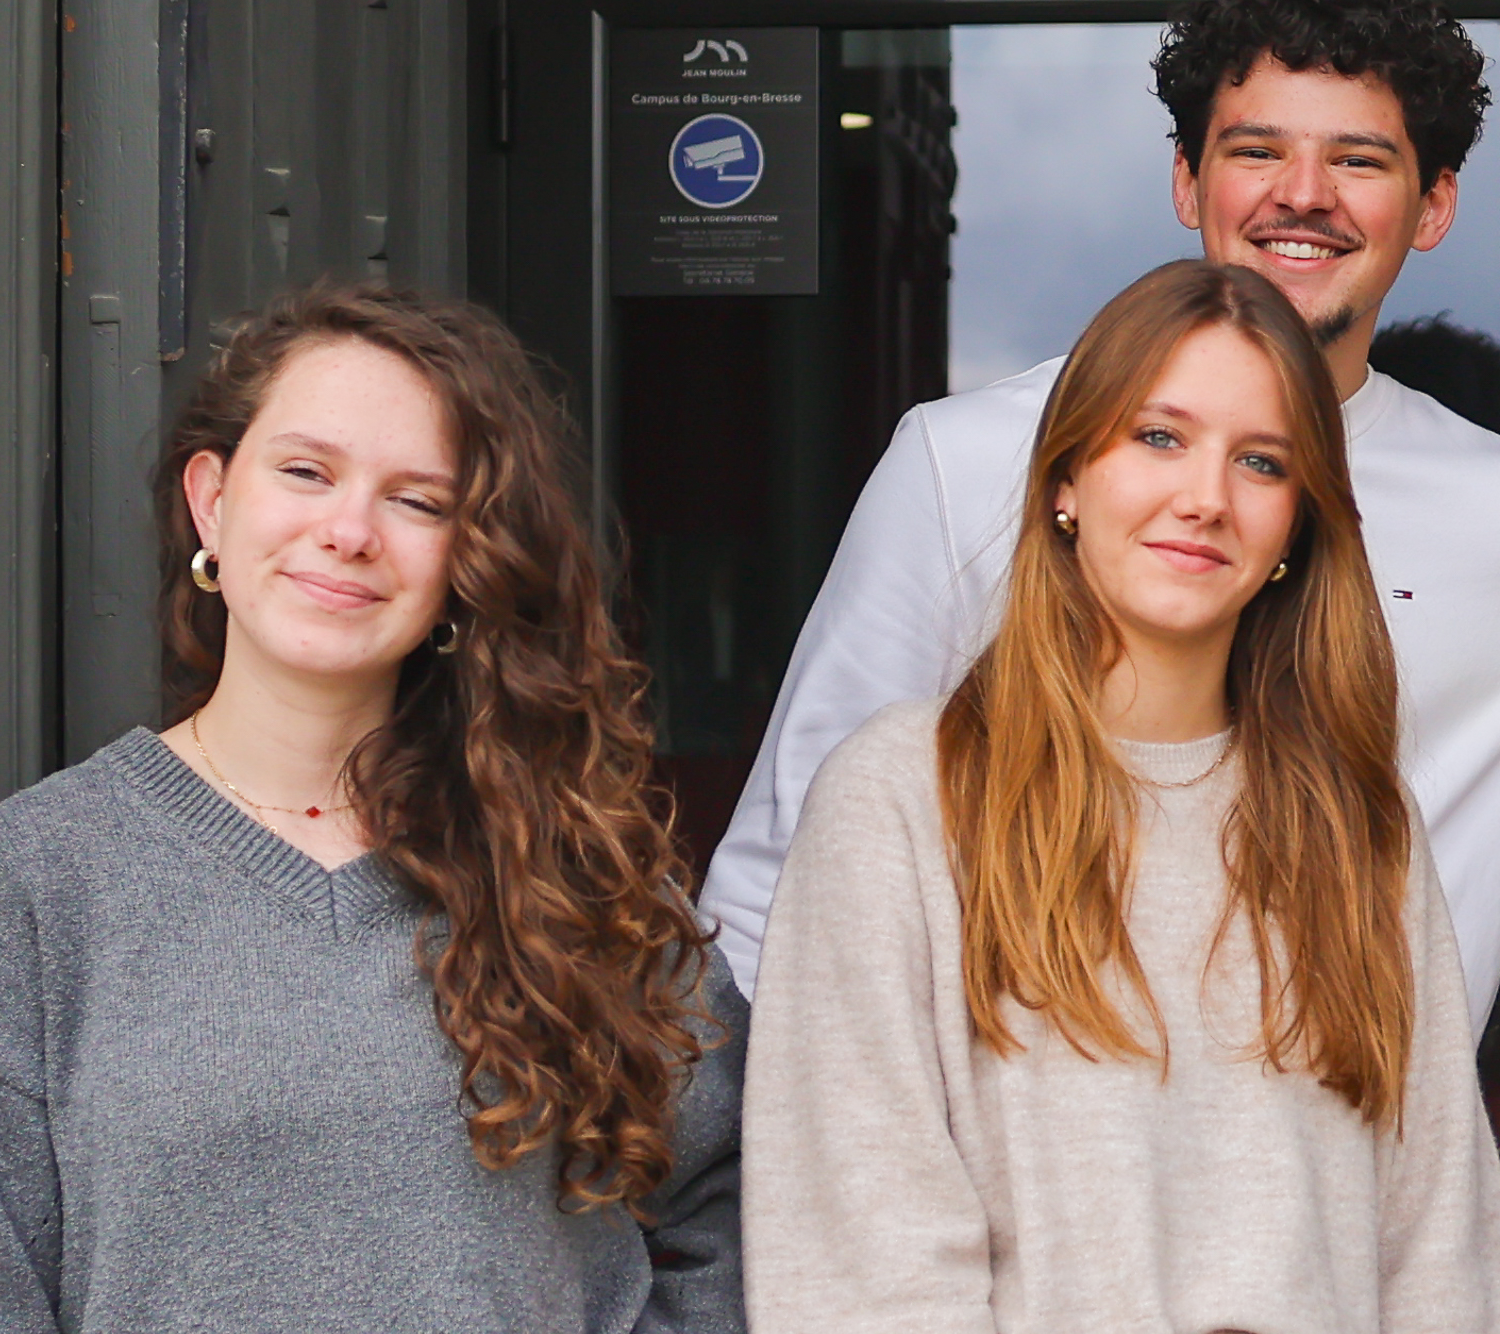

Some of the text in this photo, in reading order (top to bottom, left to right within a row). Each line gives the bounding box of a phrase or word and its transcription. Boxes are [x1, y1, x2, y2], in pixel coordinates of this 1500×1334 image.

[681, 68, 747, 78] JEAN MOULIN
[631, 92, 802, 106] Campus de Bourg-en-Bresse
[659, 215, 677, 223] SITE
[678, 215, 700, 223] SOUS
